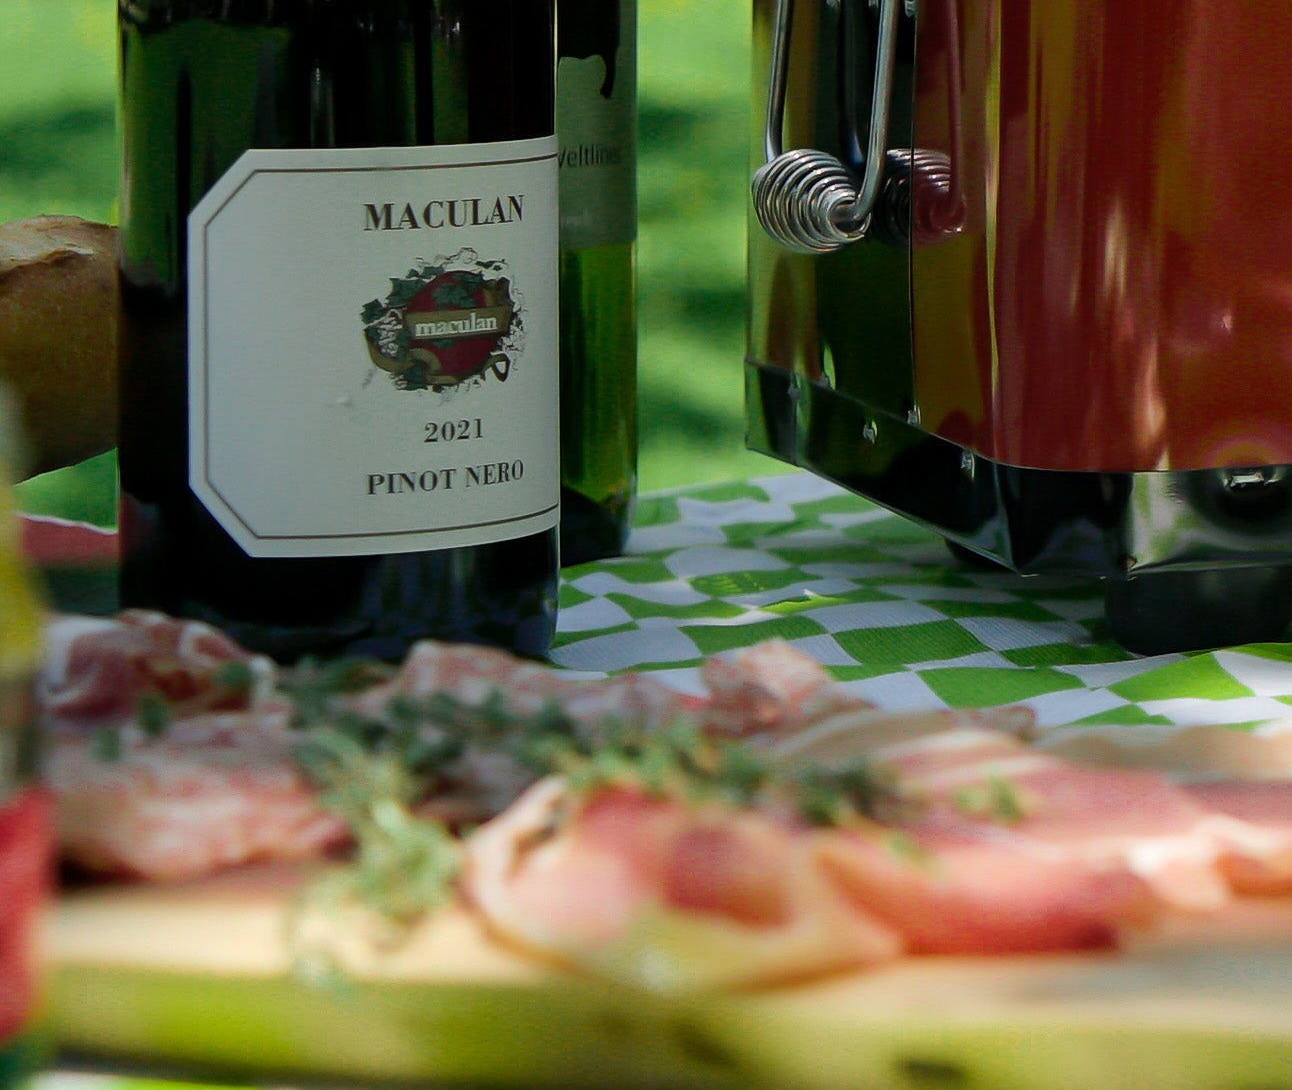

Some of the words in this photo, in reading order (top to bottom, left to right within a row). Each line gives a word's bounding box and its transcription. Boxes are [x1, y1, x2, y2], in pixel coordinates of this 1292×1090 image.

[363, 194, 525, 232] MACULAN
[415, 313, 498, 339] maculan
[424, 418, 484, 443] 2021
[366, 467, 457, 496] PINOT
[465, 459, 525, 487] NERO
